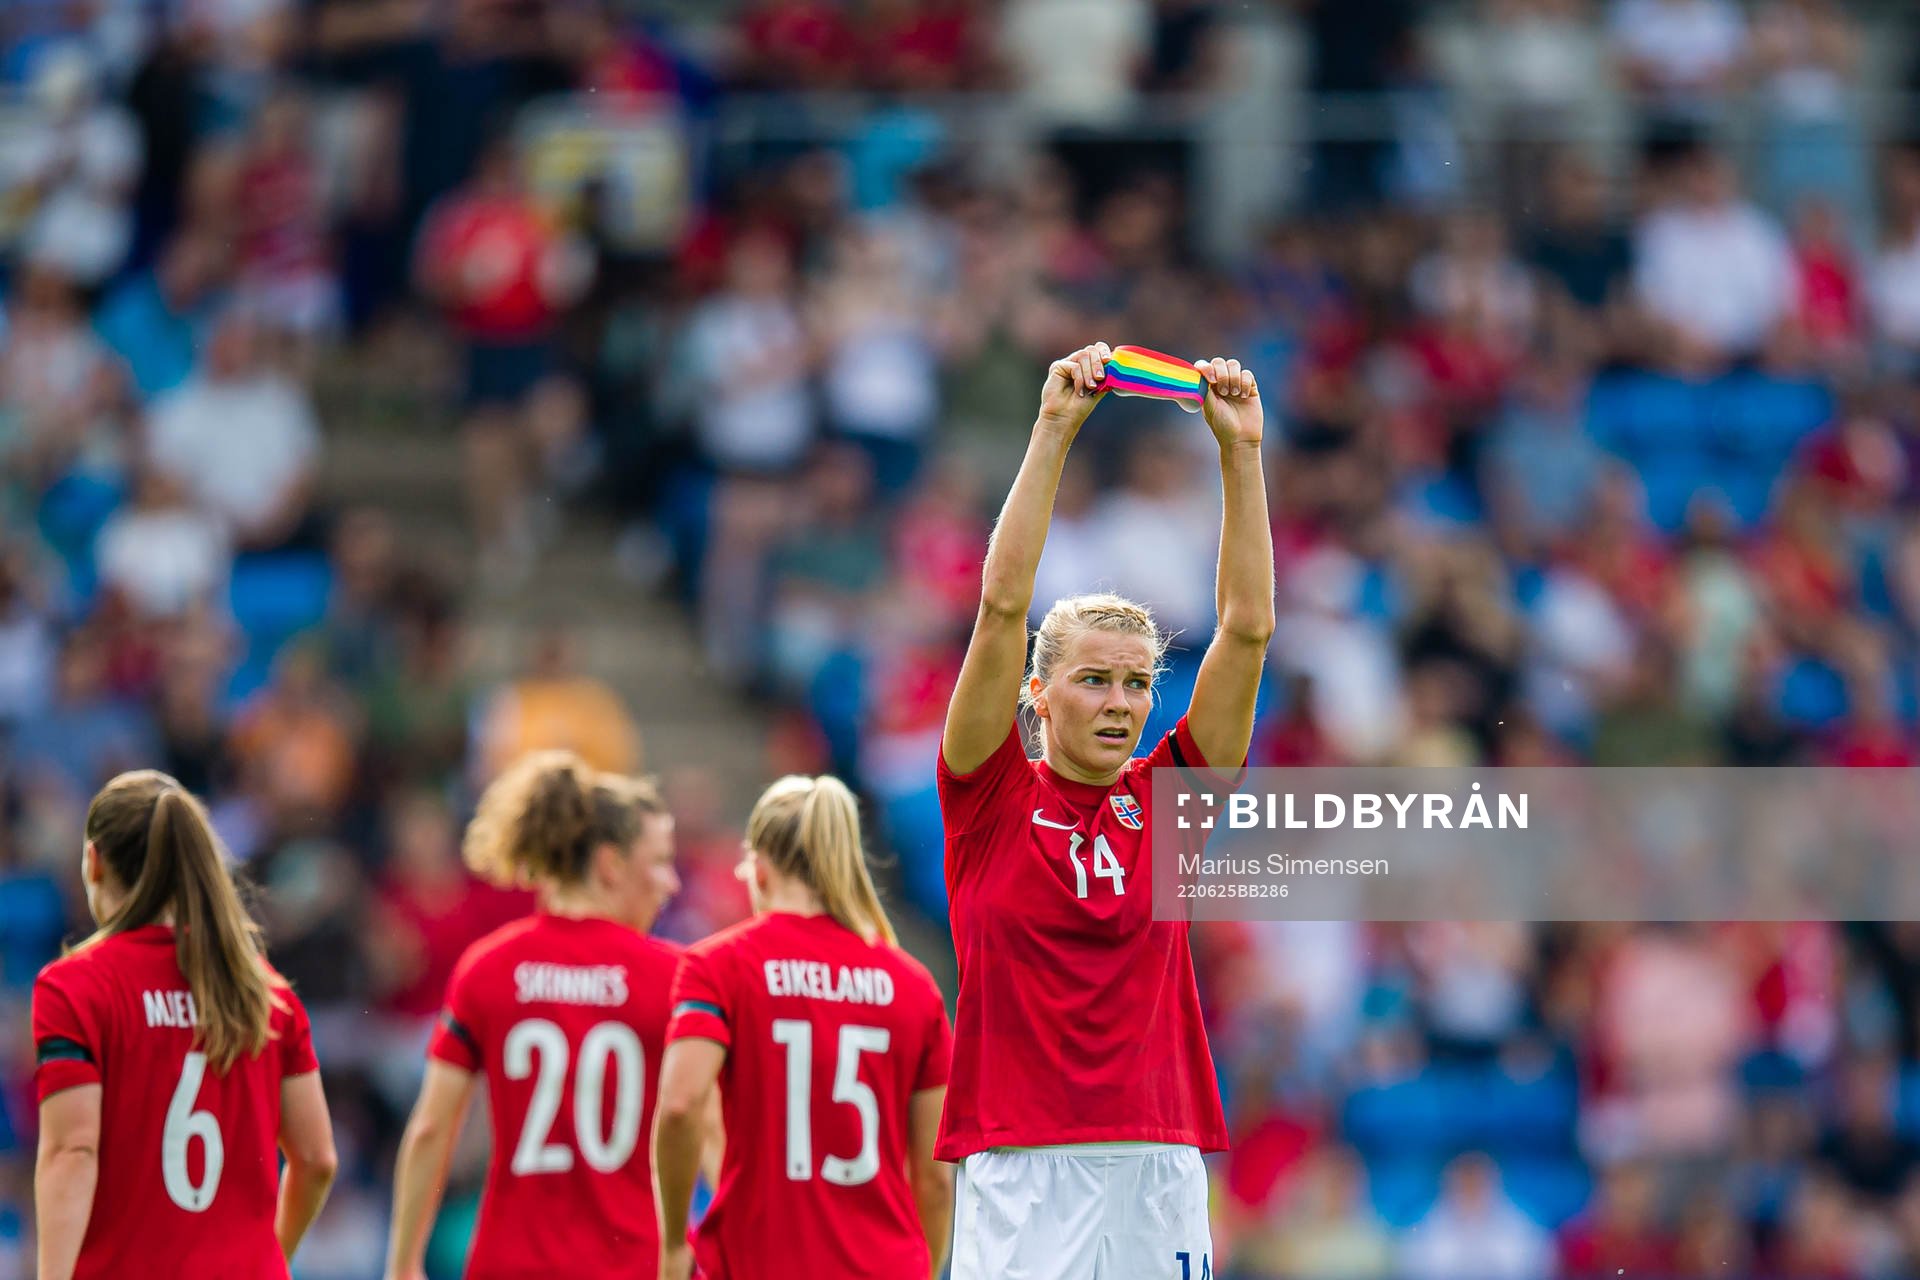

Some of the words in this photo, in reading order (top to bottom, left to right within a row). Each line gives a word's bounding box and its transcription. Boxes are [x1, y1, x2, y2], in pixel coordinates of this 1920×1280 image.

[1069, 832, 1125, 898] 14
[764, 960, 894, 1006] EIKELAND
[162, 1051, 224, 1213] 6
[504, 1017, 645, 1177] 20
[772, 1018, 891, 1186] 15
